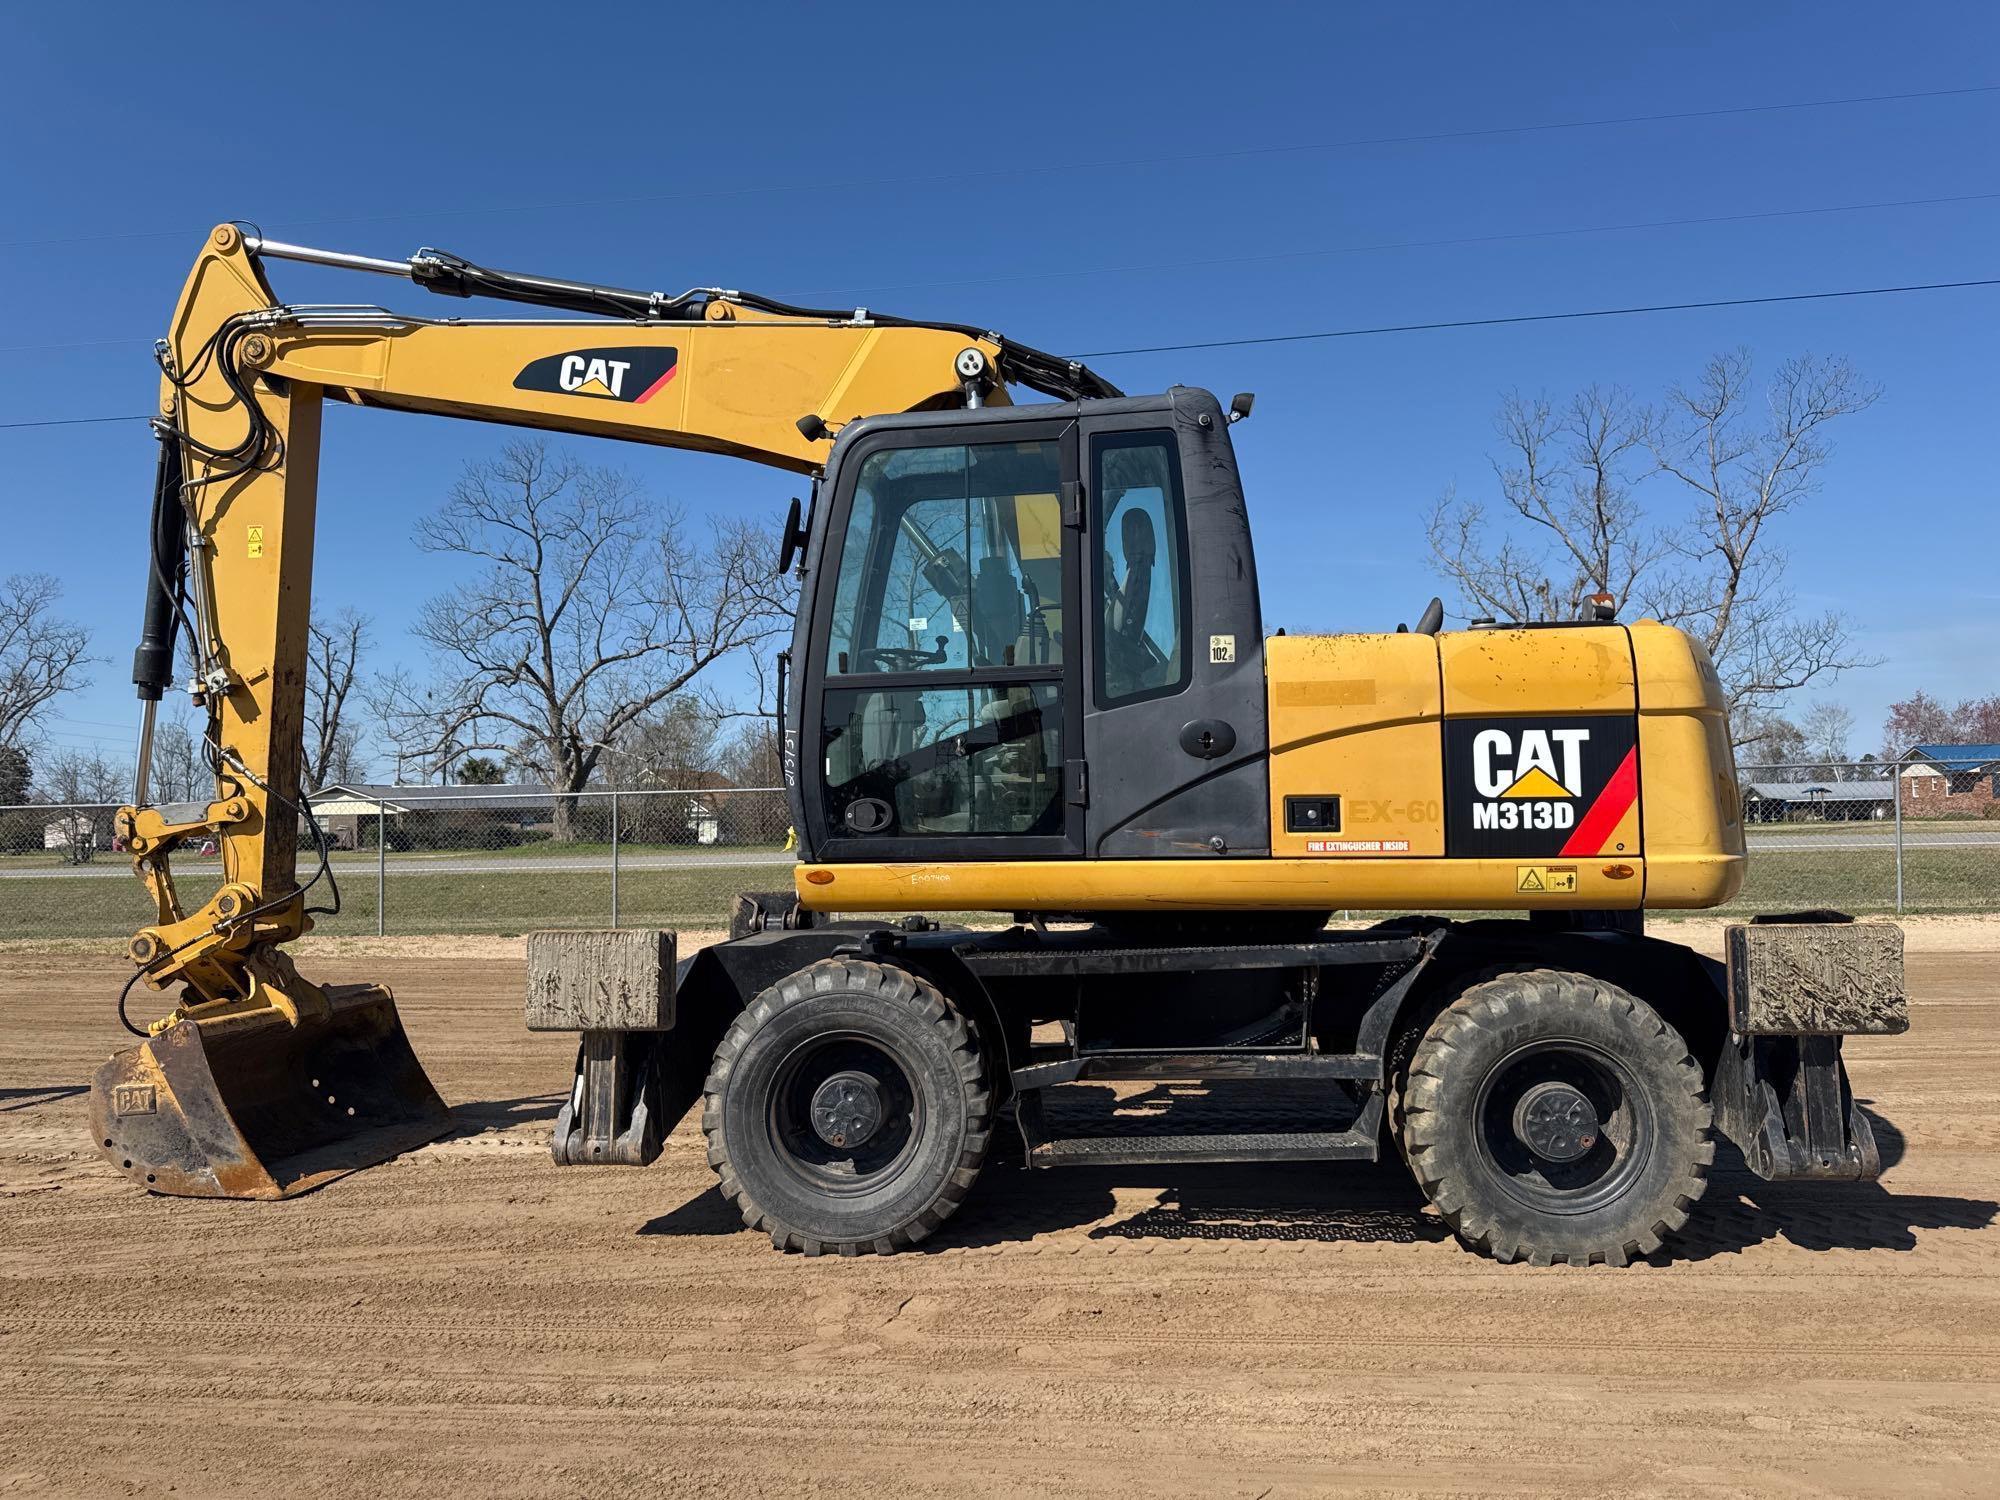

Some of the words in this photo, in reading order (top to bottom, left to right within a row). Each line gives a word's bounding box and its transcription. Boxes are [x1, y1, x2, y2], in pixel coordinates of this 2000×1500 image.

[559, 355, 631, 398] CAT
[1211, 646, 1228, 661] 102
[1473, 729, 1590, 798] CAT
[1348, 799, 1440, 823] EX-60
[1472, 801, 1575, 830] M313D
[1307, 841, 1325, 851] FIRE
[1326, 841, 1382, 851] EXTINGUISHER
[1383, 841, 1409, 851] INSIDE
